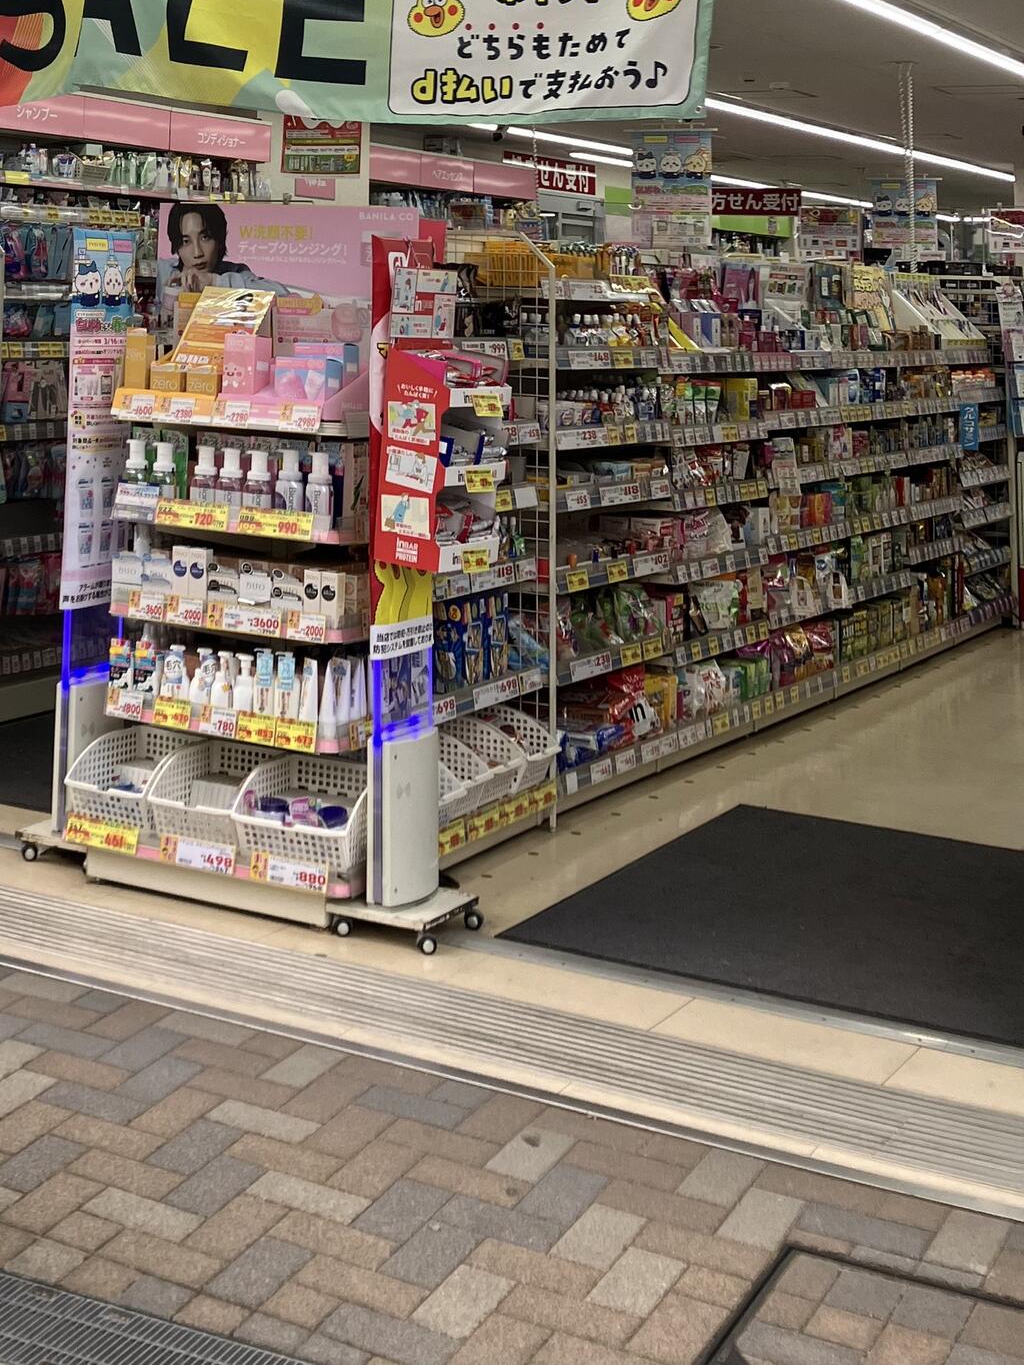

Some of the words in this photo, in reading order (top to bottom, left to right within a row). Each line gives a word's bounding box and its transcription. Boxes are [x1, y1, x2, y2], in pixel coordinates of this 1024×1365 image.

[456, 28, 632, 62] どちらもためて
[15, 104, 58, 122] シャンプー
[197, 131, 247, 148] コンディショナー
[359, 211, 396, 221] BANILA
[237, 241, 348, 256] ディープクレンジング!
[152, 377, 178, 390] zero
[188, 380, 215, 392] zero
[194, 512, 213, 526] 720
[278, 521, 297, 534] 990
[395, 551, 418, 564] PROTEIN
[146, 605, 162, 616] 3600
[184, 609, 201, 620] 2000
[252, 617, 279, 629] 3600
[305, 625, 323, 637] 2000
[217, 720, 234, 732] 780
[206, 854, 232, 867] 498
[299, 872, 326, 885] 880
